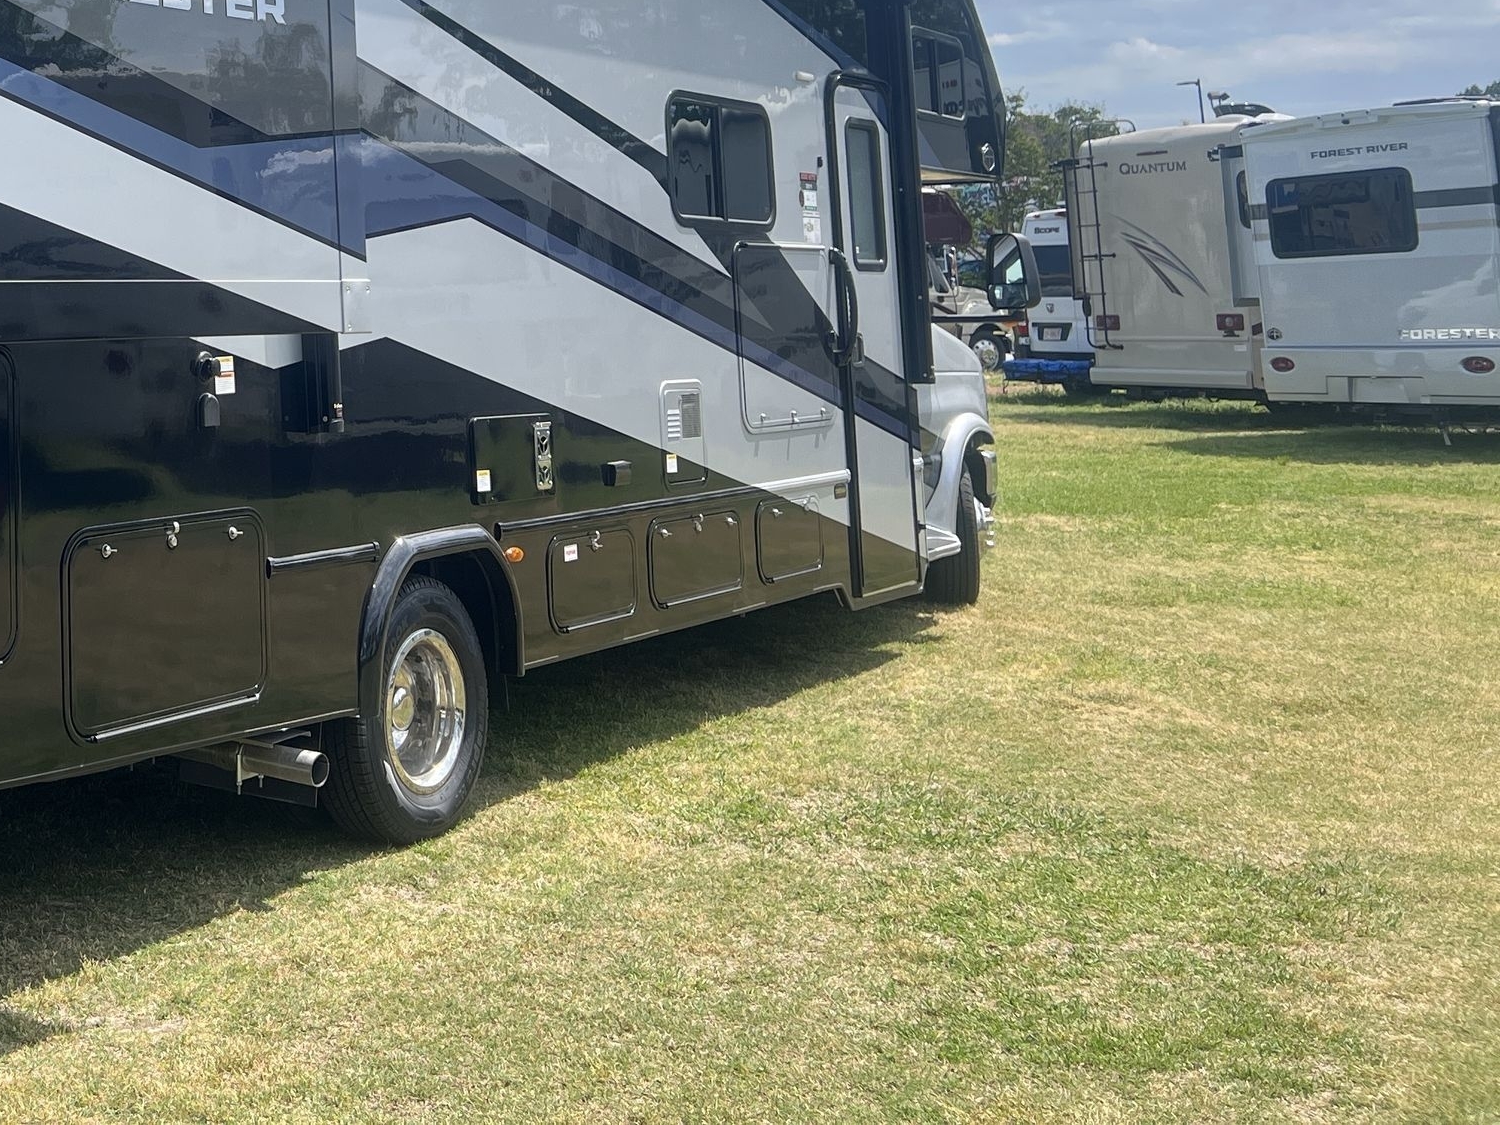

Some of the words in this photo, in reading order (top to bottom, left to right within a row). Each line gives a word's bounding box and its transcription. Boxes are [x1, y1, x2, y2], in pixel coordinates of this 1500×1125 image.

[1310, 146, 1363, 159] FOREST
[1366, 142, 1408, 154] RIVER
[1119, 161, 1187, 175] QUANTUM
[1398, 328, 1500, 340] FORESTER
